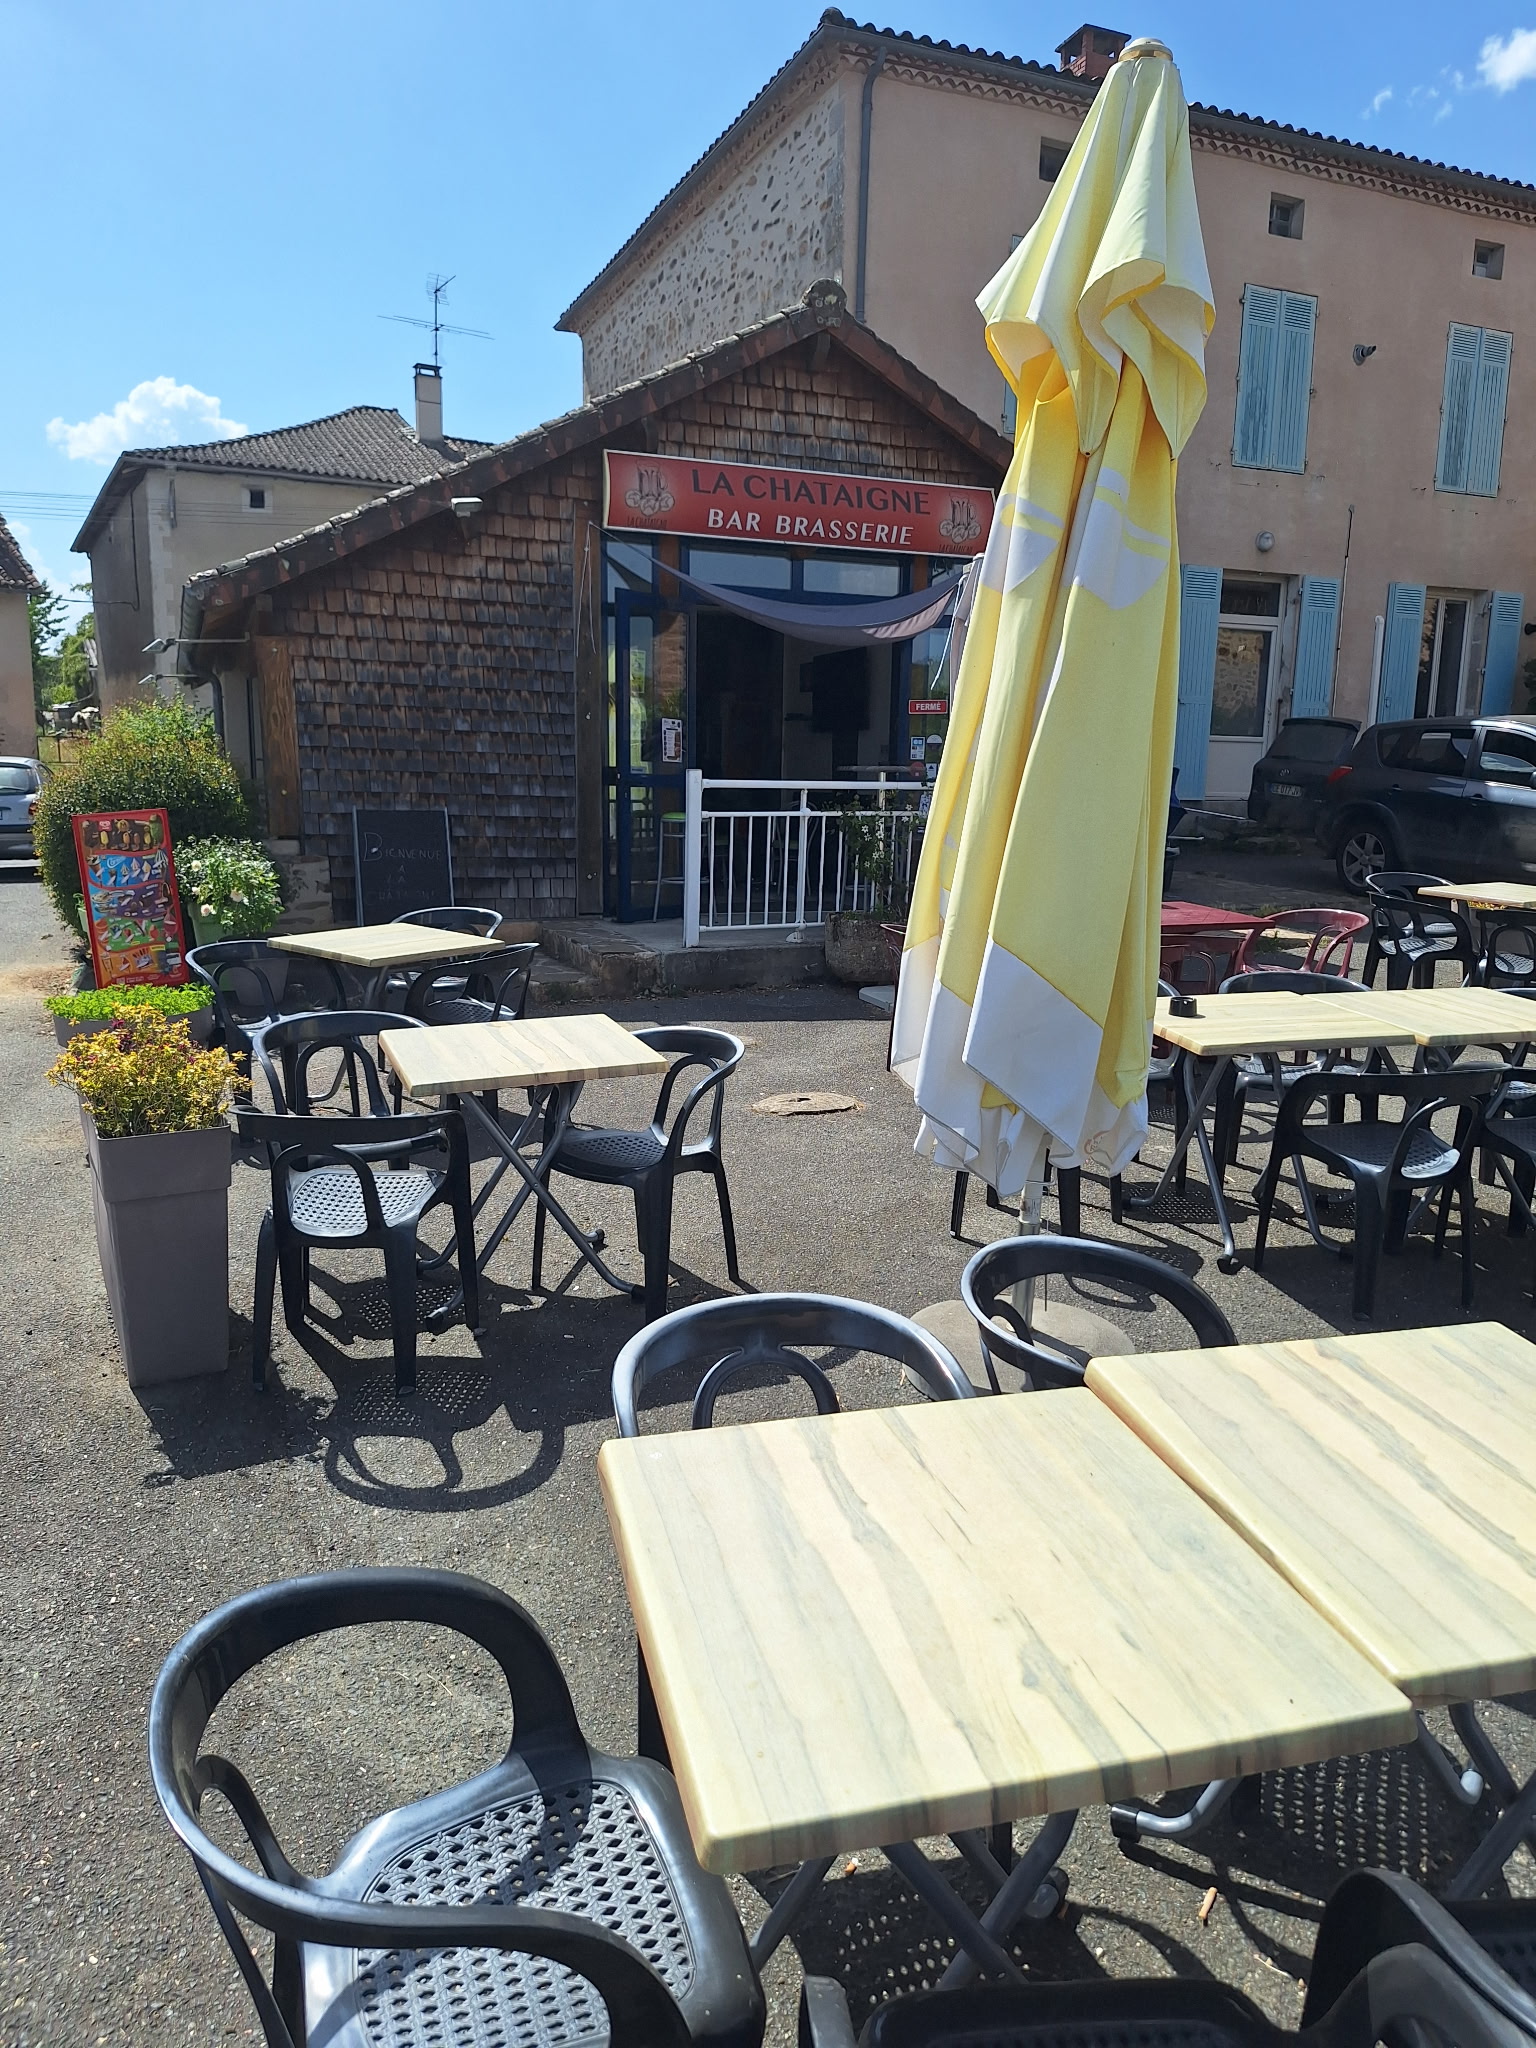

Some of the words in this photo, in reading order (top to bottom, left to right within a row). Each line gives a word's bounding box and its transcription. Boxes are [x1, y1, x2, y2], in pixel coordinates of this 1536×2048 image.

[692, 468, 735, 497] LA
[743, 474, 931, 516] CHATAIGNE
[708, 508, 761, 532] BAR
[776, 515, 914, 545] BRASSERIE
[916, 701, 941, 712] FERMÉ
